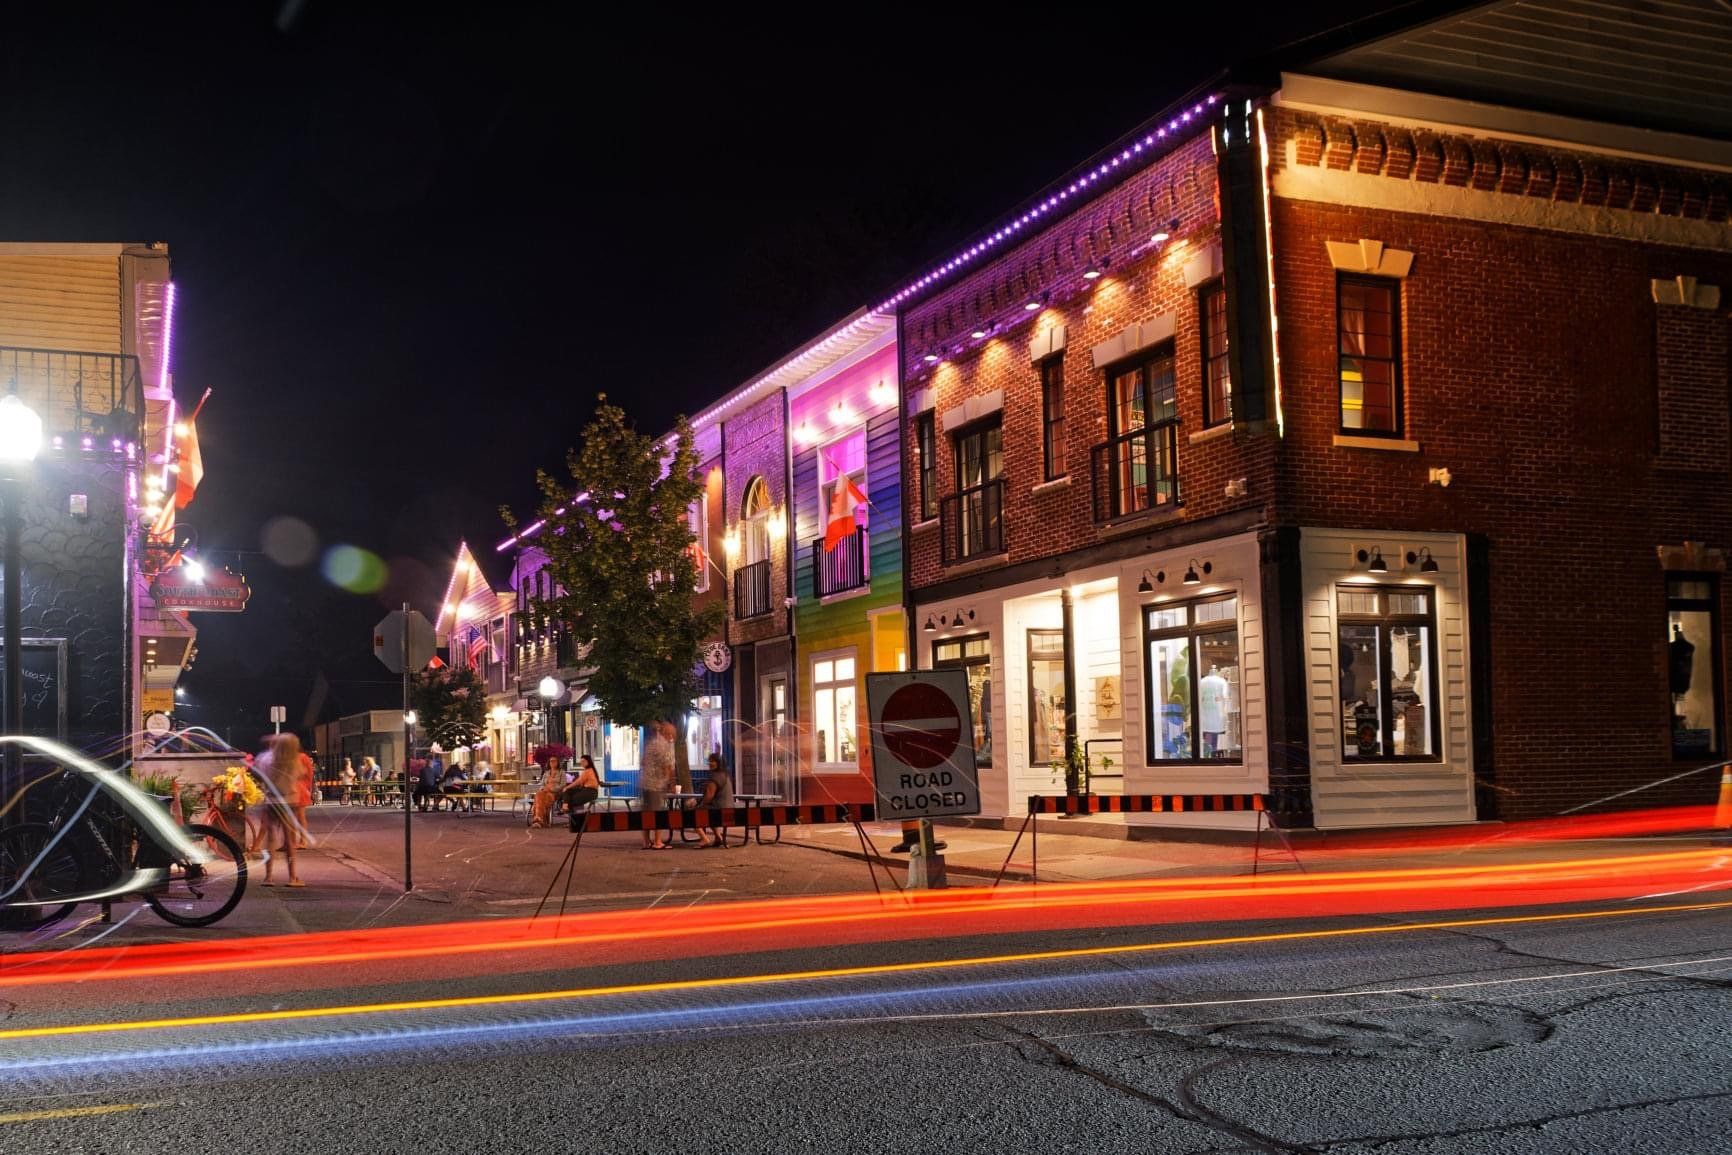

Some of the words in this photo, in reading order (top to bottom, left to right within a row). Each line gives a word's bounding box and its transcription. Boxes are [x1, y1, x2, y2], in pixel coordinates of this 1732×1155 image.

[164, 599, 236, 607] COOKHOUSE
[21, 668, 54, 689] coast
[900, 771, 953, 789] ROAD
[890, 791, 966, 811] CLOSED
